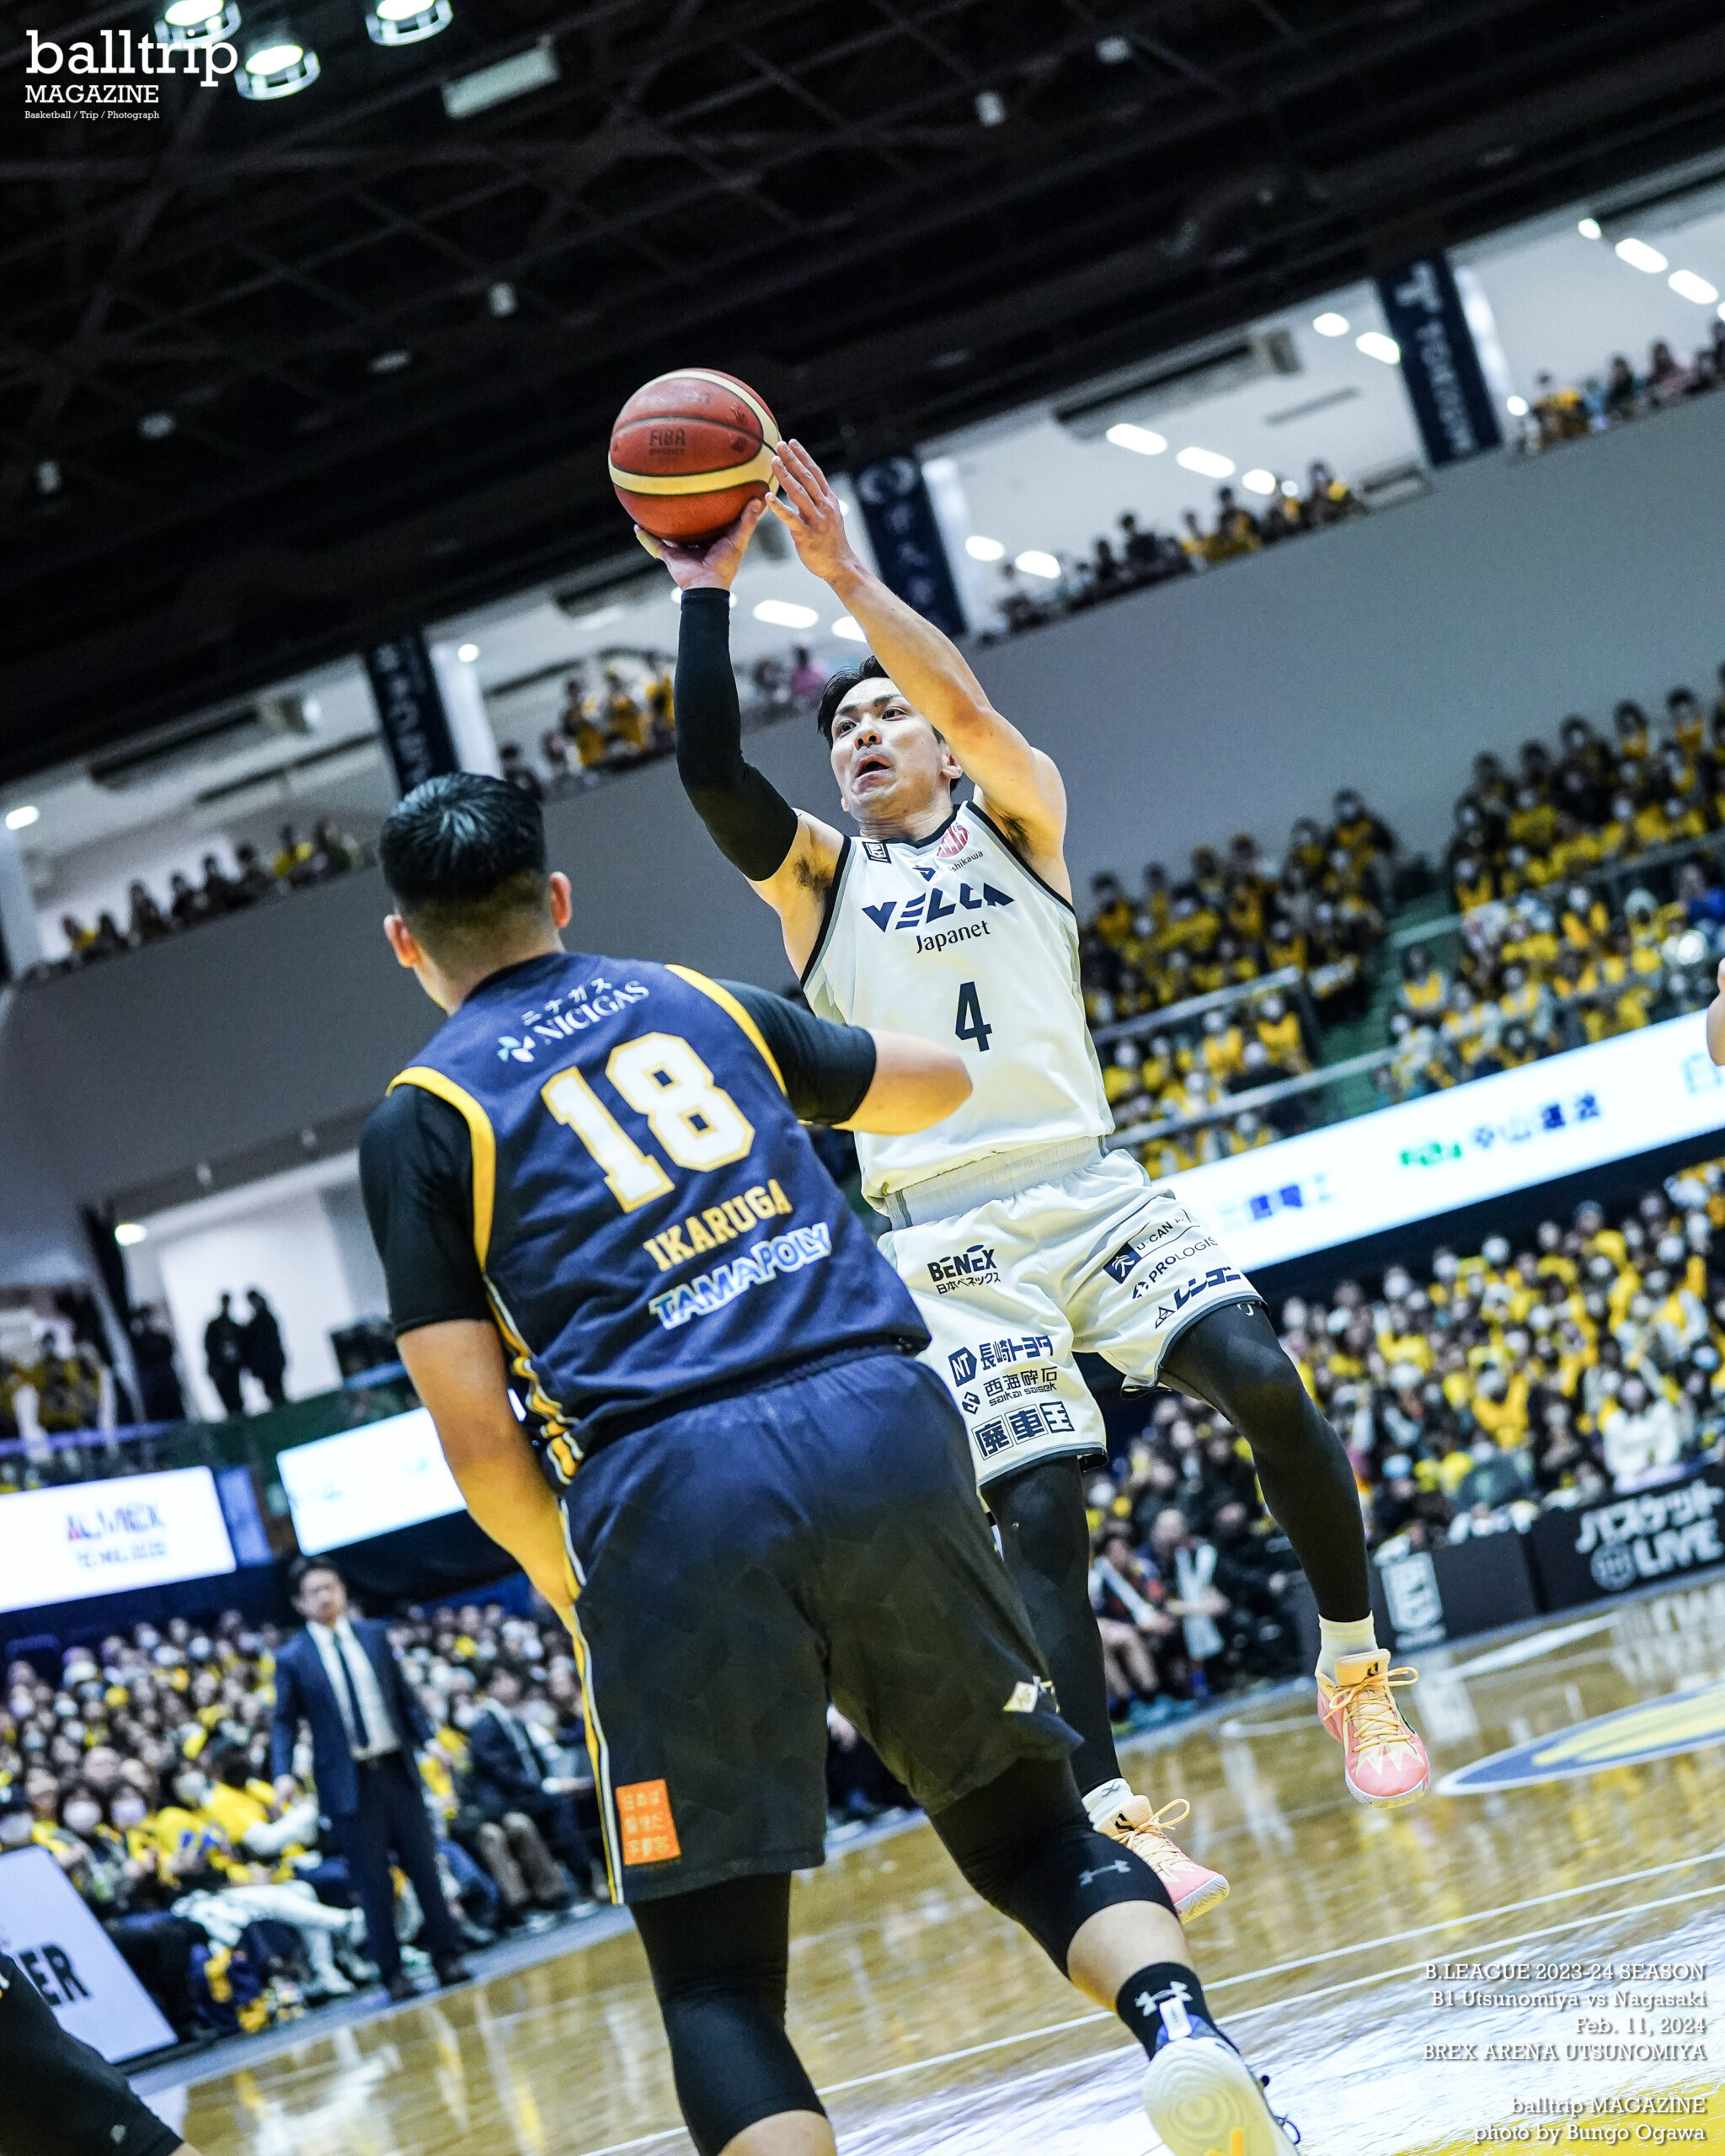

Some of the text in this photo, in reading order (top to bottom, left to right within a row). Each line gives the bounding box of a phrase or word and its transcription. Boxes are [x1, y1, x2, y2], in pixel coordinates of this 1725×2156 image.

[649, 430, 686, 446] FIBA
[862, 883, 1015, 933] VELCA
[916, 920, 991, 954] Japanet
[533, 980, 649, 1044] NICIGAS
[955, 981, 993, 1052] 4
[541, 1031, 756, 1213] 18
[644, 1179, 793, 1272] IKARUGA
[649, 1223, 833, 1330] TAMAPOLY
[927, 1245, 997, 1283] BENEX
[936, 1272, 1001, 1294] 日本ベネックス
[1148, 1236, 1218, 1283] PROLOGIS
[1173, 1266, 1242, 1310] レンゴー
[952, 1353, 971, 1381] NT
[978, 1335, 1054, 1371] 長崎トヨタ
[983, 1366, 1058, 1397] 西海砕石
[971, 1401, 1076, 1460] 廃車王
[1633, 1518, 1724, 1577] LIVE
